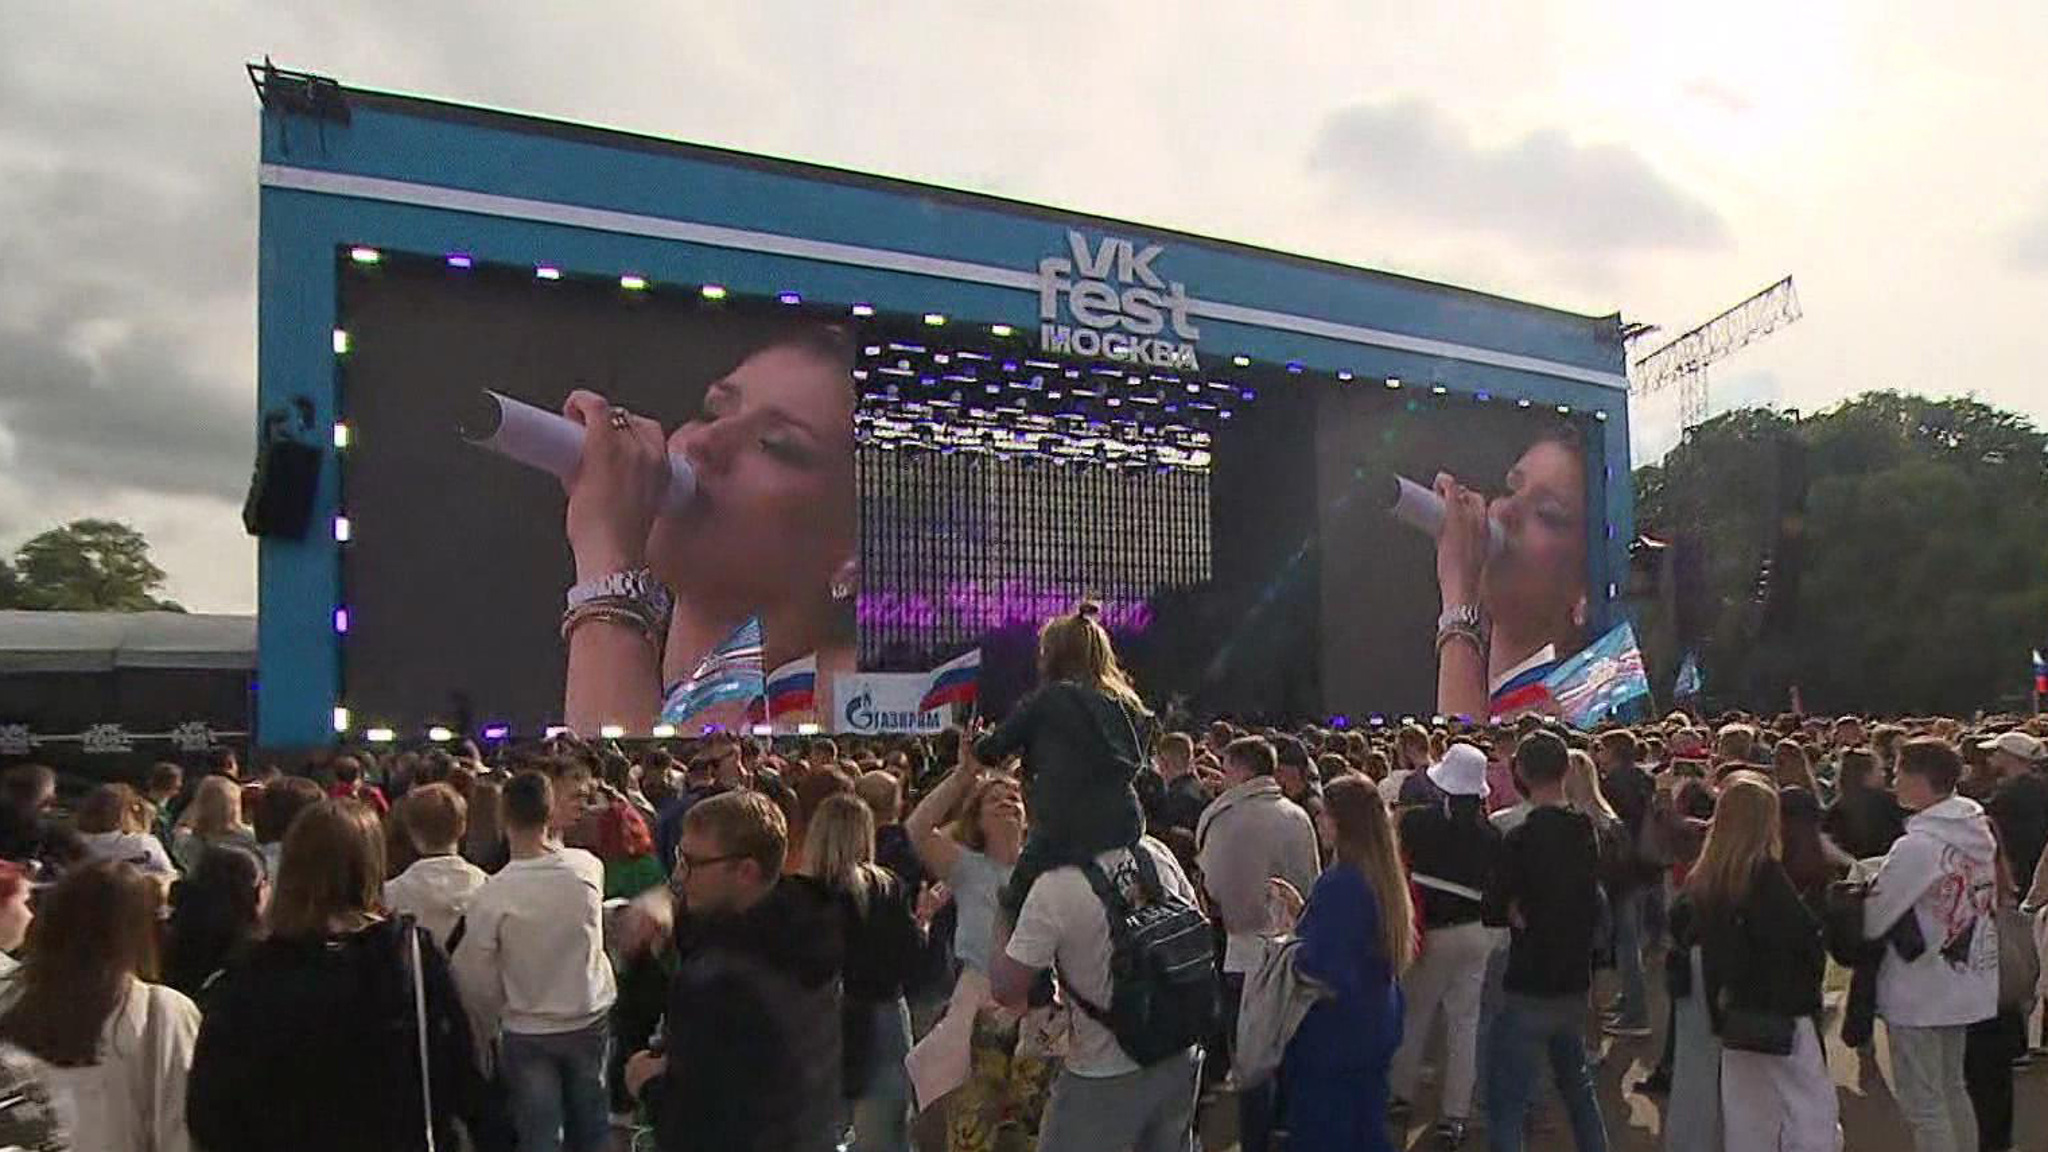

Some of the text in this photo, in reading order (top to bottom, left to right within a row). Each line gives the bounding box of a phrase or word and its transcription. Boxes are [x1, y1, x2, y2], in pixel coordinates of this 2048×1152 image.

[1070, 230, 1166, 289] VK
[1040, 257, 1199, 340] fest
[1041, 323, 1199, 371] МОСКВА
